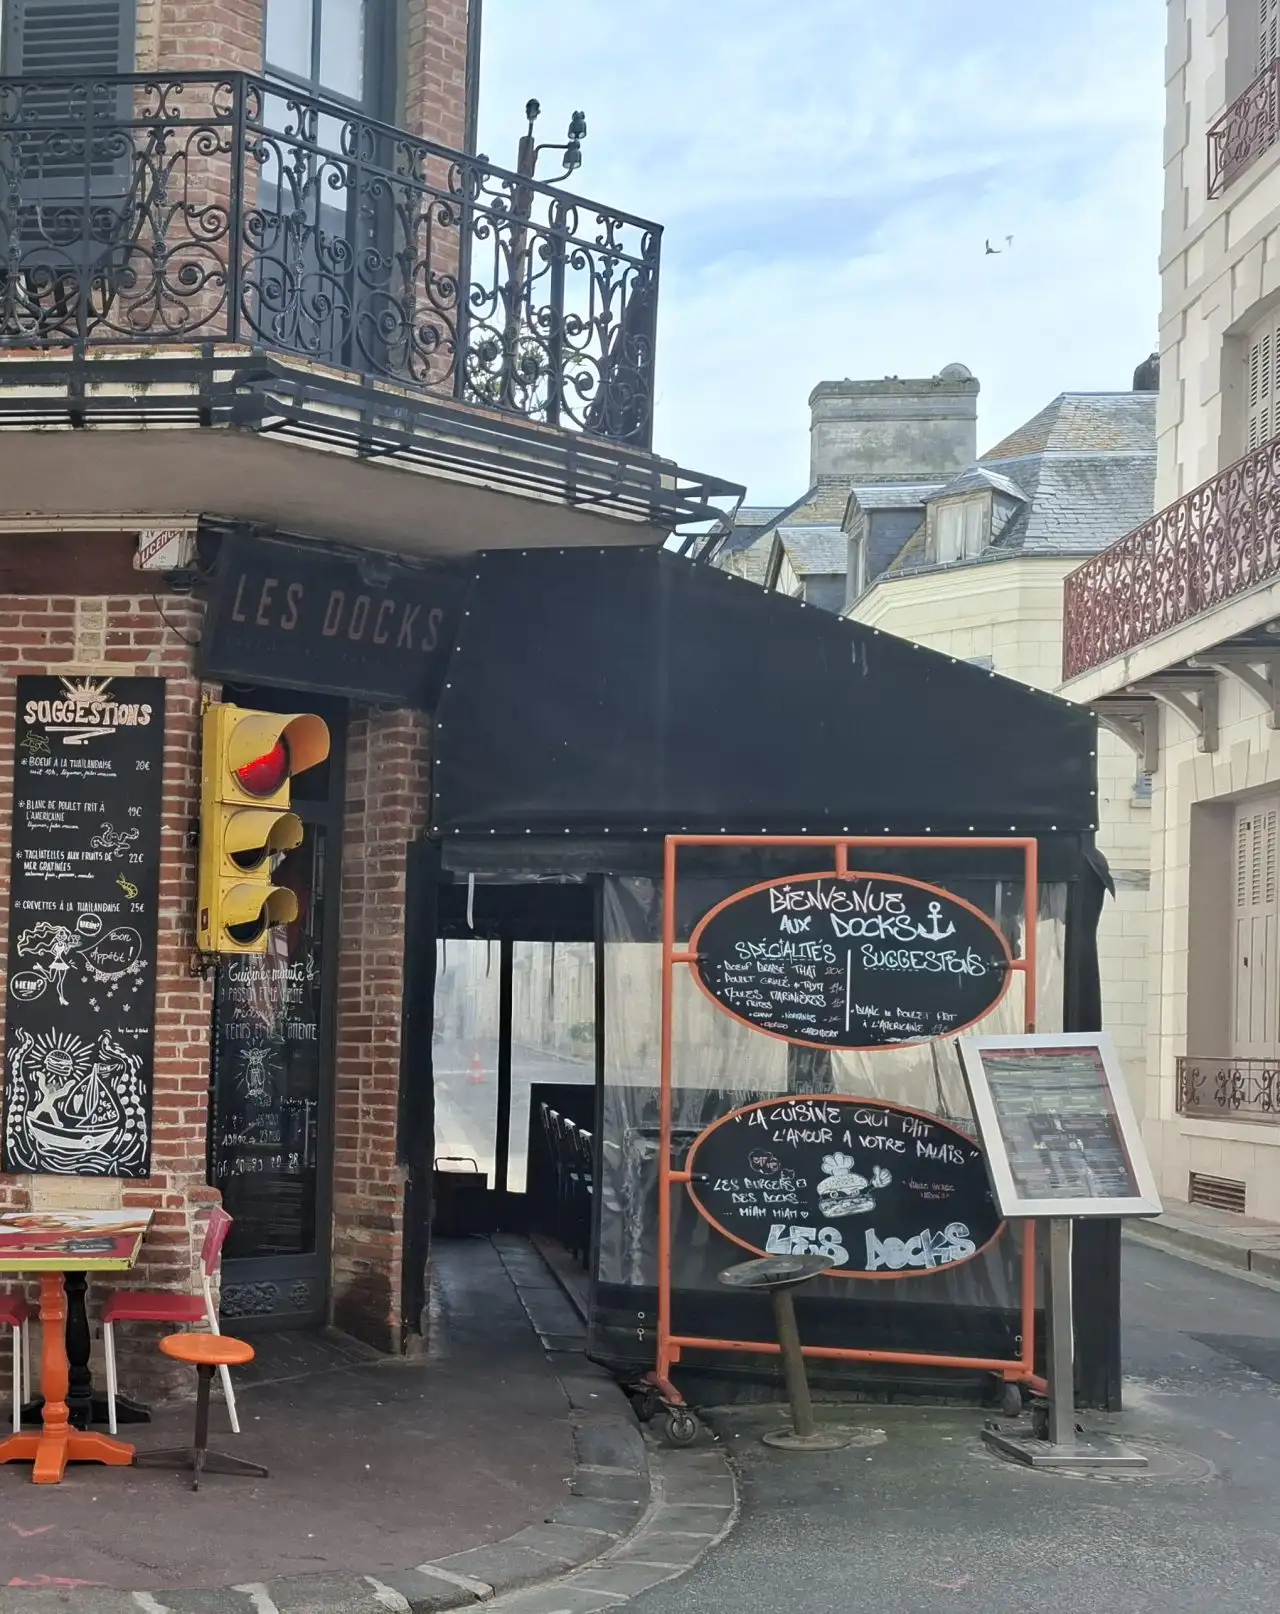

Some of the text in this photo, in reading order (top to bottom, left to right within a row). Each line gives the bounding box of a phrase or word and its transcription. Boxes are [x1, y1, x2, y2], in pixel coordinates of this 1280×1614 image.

[141, 530, 179, 563] LICENC
[232, 574, 443, 651] LES DOCKS
[23, 700, 152, 725] SUGGESTIONS
[60, 759, 68, 768] LA
[135, 760, 150, 771] 20€
[26, 800, 46, 810] BLANC
[48, 800, 56, 810] DE
[58, 800, 81, 811] POULET
[84, 802, 98, 812] FRIT
[128, 806, 143, 817] 19€
[24, 849, 144, 863] TAGLIATELLES AUX FRUITS DE 22€
[24, 861, 37, 870] MER
[770, 880, 906, 914] BIENVENUE
[23, 900, 56, 911] CREVETTES
[66, 902, 73, 911] LA
[130, 903, 144, 912] 25€
[780, 913, 919, 941] AUX DOCKS
[111, 932, 131, 942] Bon
[735, 938, 836, 964] SPÉCIALITÉS
[861, 944, 986, 976] SUGGESTIONS
[724, 972, 756, 983] POULET
[724, 987, 763, 1002] MOULES
[748, 1100, 934, 1137] LA CUISINE QUI FAIT
[773, 1128, 832, 1149] L'AMOUR
[859, 1136, 906, 1153] VOTRE
[916, 1141, 965, 1164] PALAIS
[713, 1178, 795, 1192] LES BURGERS
[732, 1193, 757, 1203] DES
[739, 1206, 797, 1219] MIAM MIAM
[766, 1222, 976, 1271] LES DOCKS
